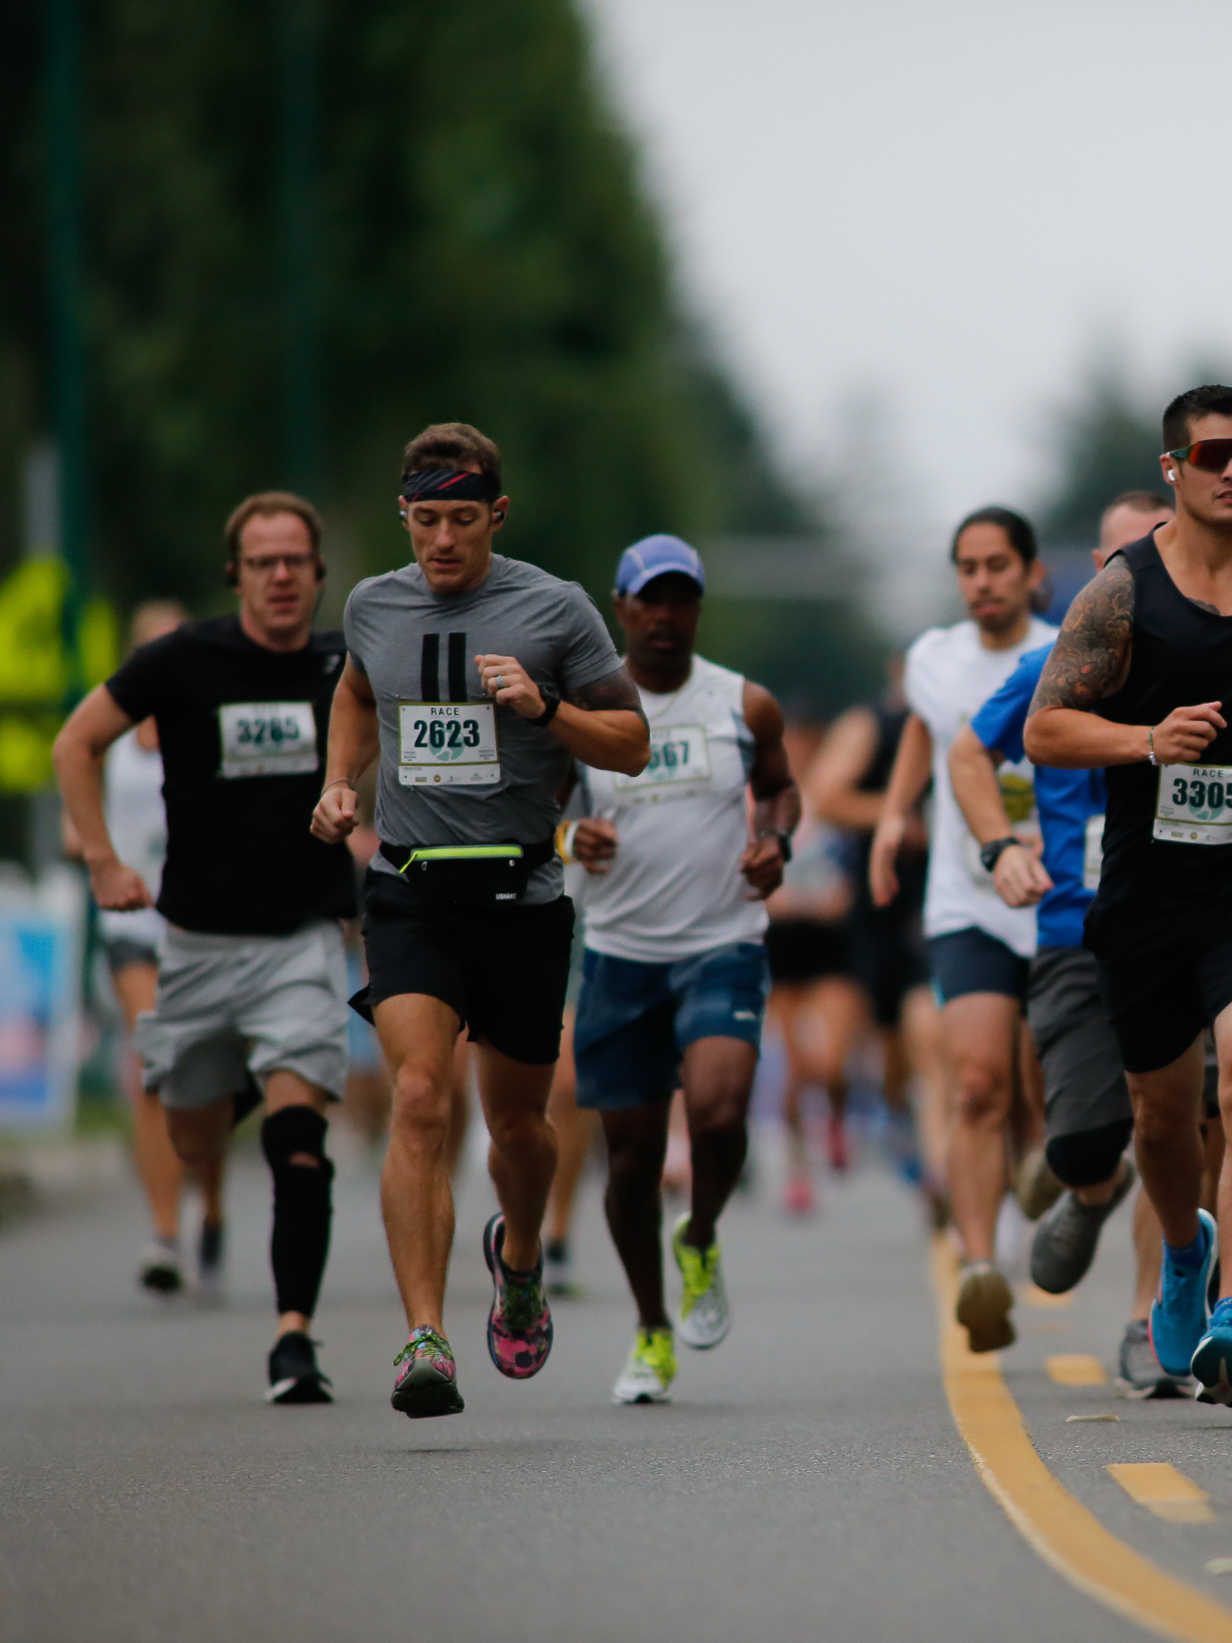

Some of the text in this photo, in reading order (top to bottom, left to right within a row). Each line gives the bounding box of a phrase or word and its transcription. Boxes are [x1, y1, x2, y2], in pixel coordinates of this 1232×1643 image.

[430, 707, 460, 716] RACE
[414, 719, 480, 748] 2623
[1193, 768, 1225, 778] RACE
